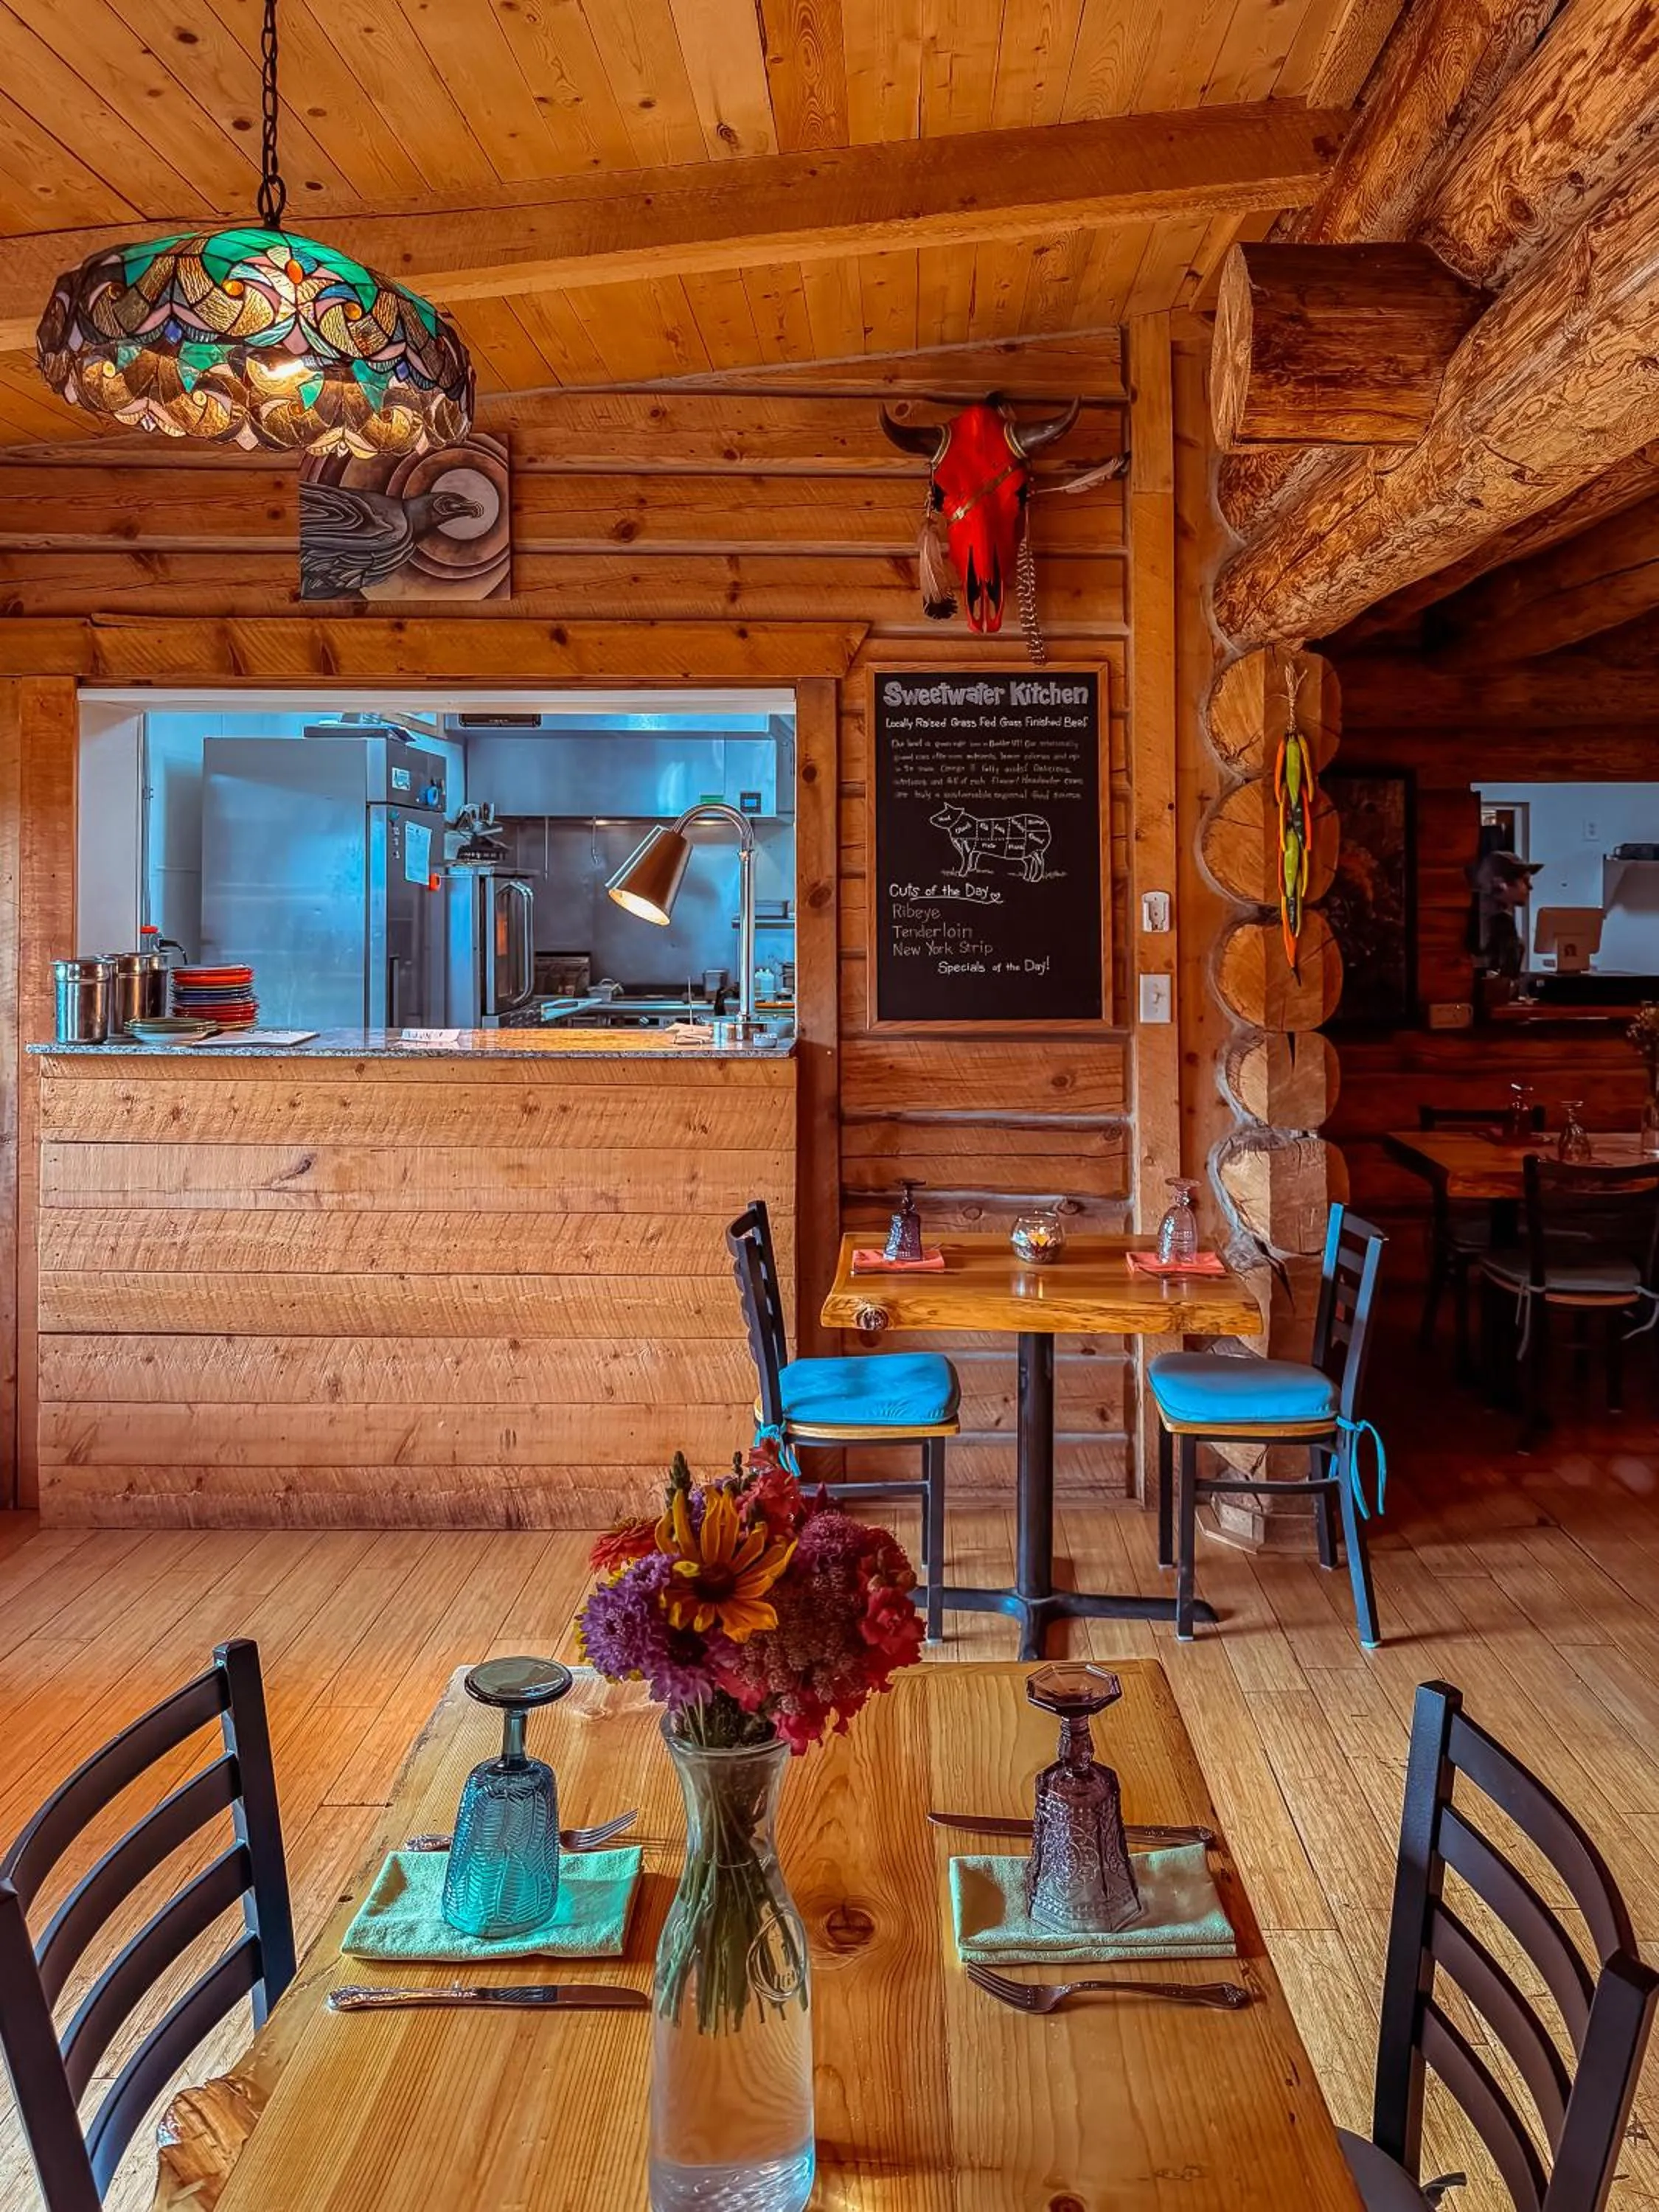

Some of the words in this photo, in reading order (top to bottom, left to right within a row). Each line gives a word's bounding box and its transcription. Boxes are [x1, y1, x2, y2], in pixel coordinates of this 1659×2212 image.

[883, 681, 1005, 707] Sweetwater
[1009, 681, 1089, 706] Kitchen
[886, 717, 913, 730] Locally
[915, 717, 947, 728] Raised
[950, 717, 976, 728] Grass
[979, 716, 996, 727] Fed
[999, 717, 1022, 728] Grass
[1025, 716, 1062, 727] Finished
[1064, 716, 1089, 728] Beef
[889, 883, 919, 897] Cuts
[925, 885, 937, 896] of
[942, 885, 960, 897] the
[965, 882, 989, 900] Day
[892, 902, 941, 924] Ribeye
[892, 922, 973, 939] Tenderloin
[893, 942, 920, 956] New
[926, 940, 953, 956] York
[959, 940, 993, 956] Strip
[937, 961, 985, 975] Specials
[992, 962, 1001, 973] of
[1005, 961, 1020, 971] the
[1023, 955, 1049, 975] Day!
